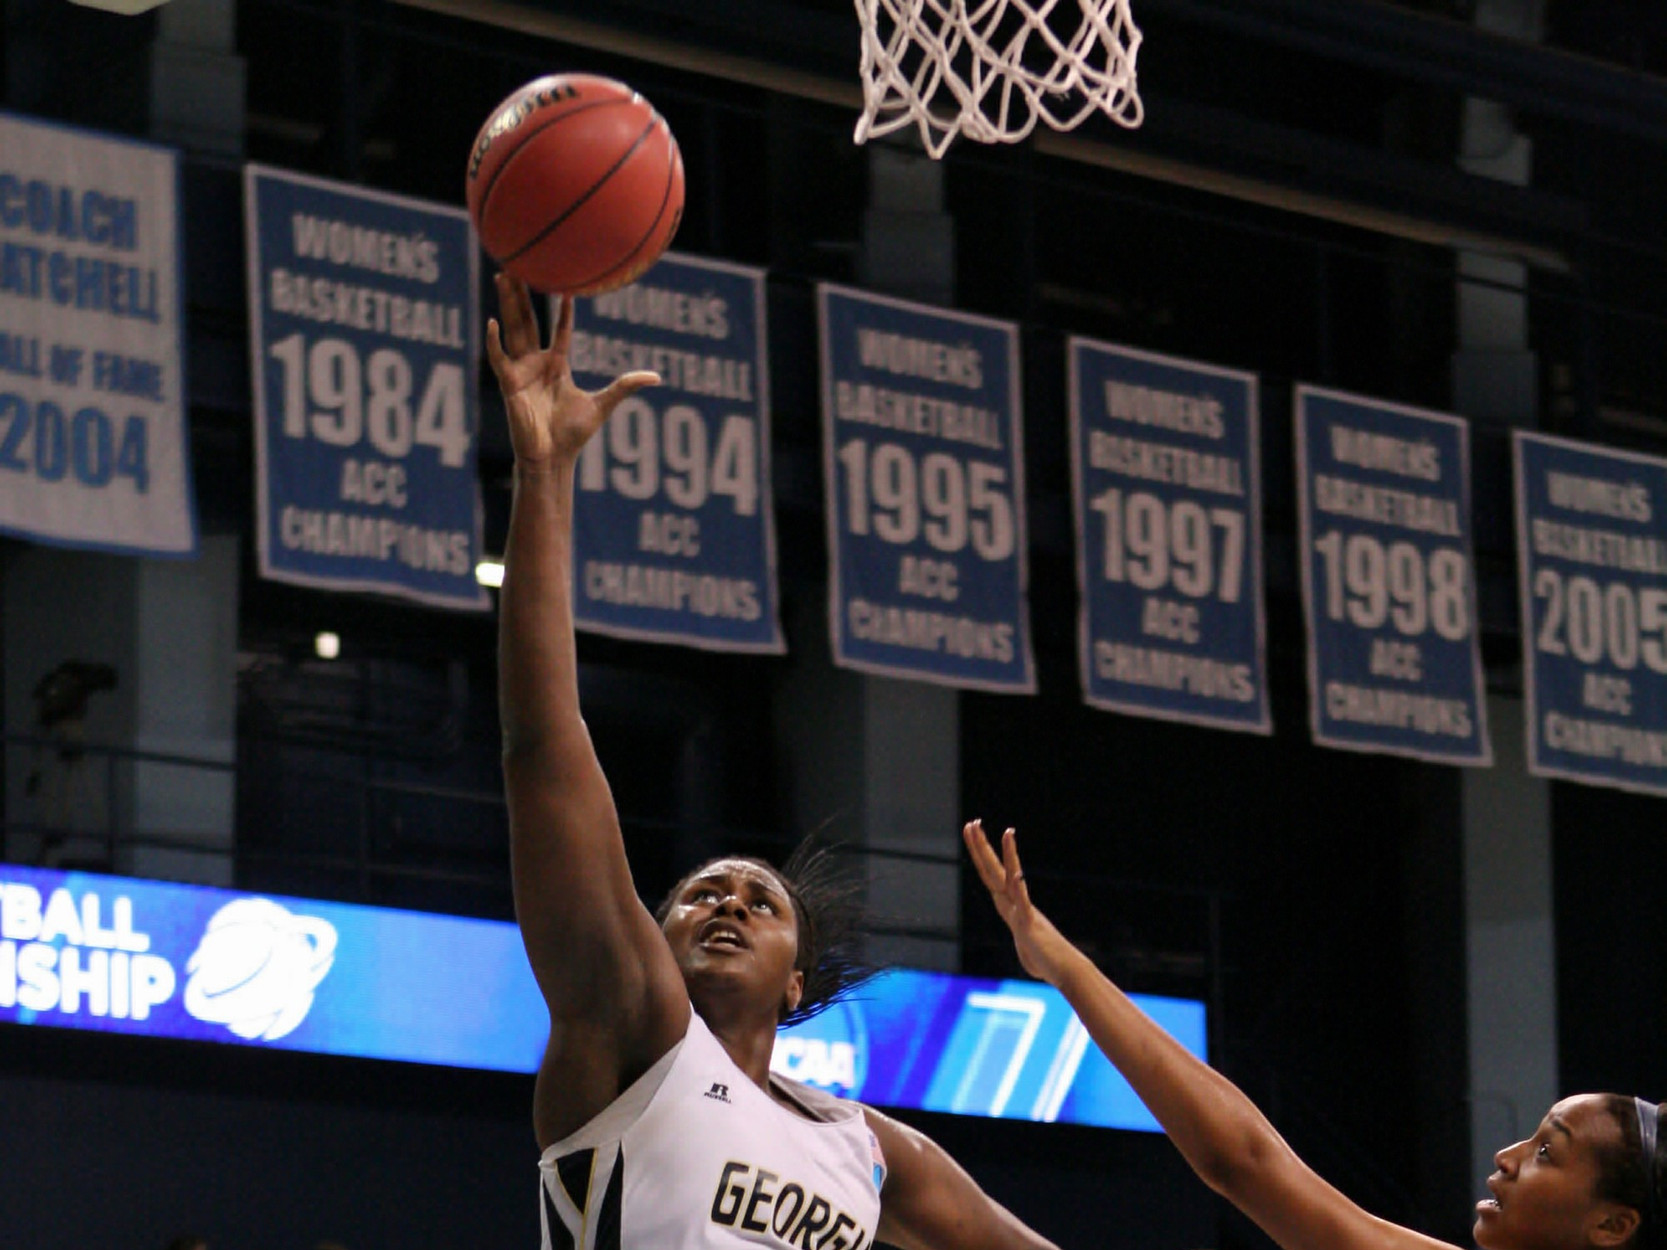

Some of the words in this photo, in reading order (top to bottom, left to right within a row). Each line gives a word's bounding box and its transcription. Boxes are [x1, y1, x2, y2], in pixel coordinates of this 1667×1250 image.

[293, 213, 439, 283] WOMEN'S
[271, 267, 465, 348] BASKETBALL
[272, 333, 470, 469] 1984
[0, 392, 149, 494] 2004
[580, 395, 758, 517] 1994
[341, 459, 408, 509] ACC
[838, 437, 1015, 562] 1995
[280, 505, 470, 576] CHAMPIONS
[637, 511, 700, 558] ACC
[1089, 487, 1246, 603] 1997
[585, 560, 761, 623] CHAMPIONS
[899, 556, 958, 602] ACC
[1315, 529, 1468, 642] 1998
[848, 599, 1014, 665] CHAMPIONS
[1533, 568, 1667, 675] 2005
[1, 882, 150, 953] BALL
